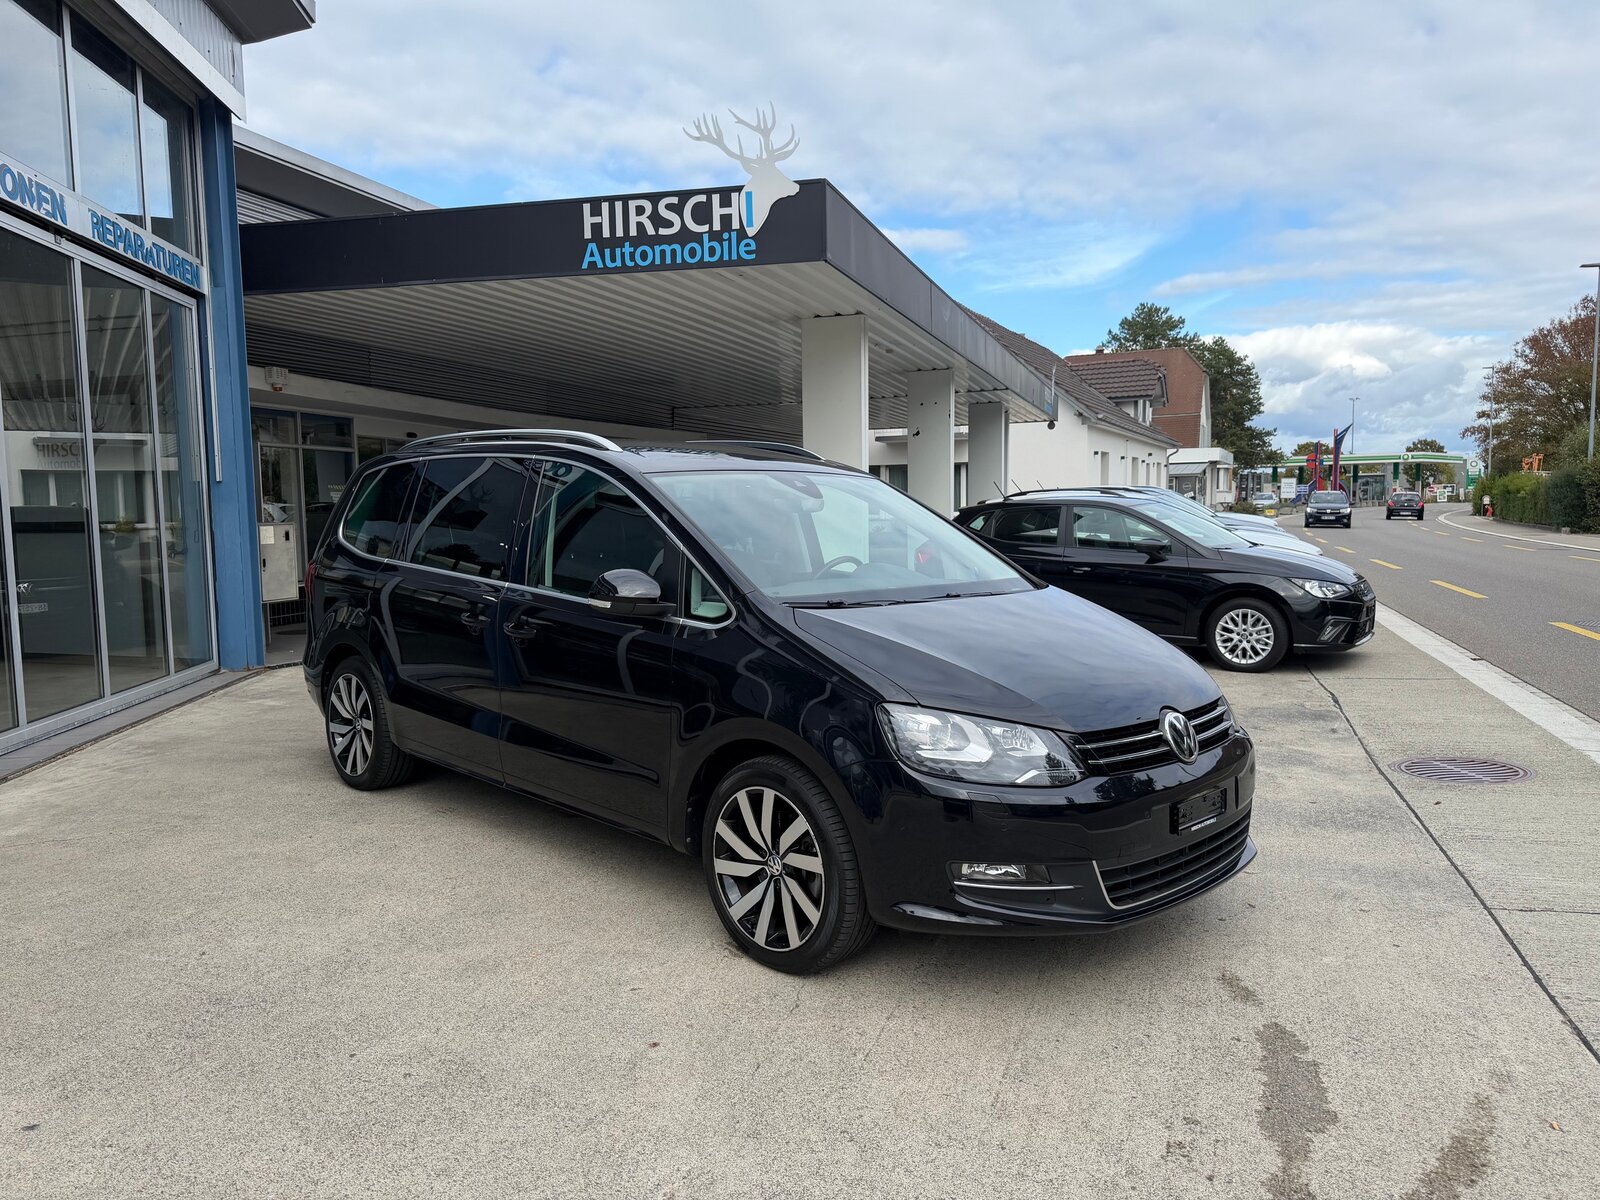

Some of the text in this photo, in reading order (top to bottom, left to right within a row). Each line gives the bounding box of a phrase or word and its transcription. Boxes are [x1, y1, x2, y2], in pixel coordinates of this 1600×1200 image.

[88, 208, 200, 288] REPARATUREN
[581, 231, 757, 270] Automobile
[36, 441, 81, 457] HIRSC
